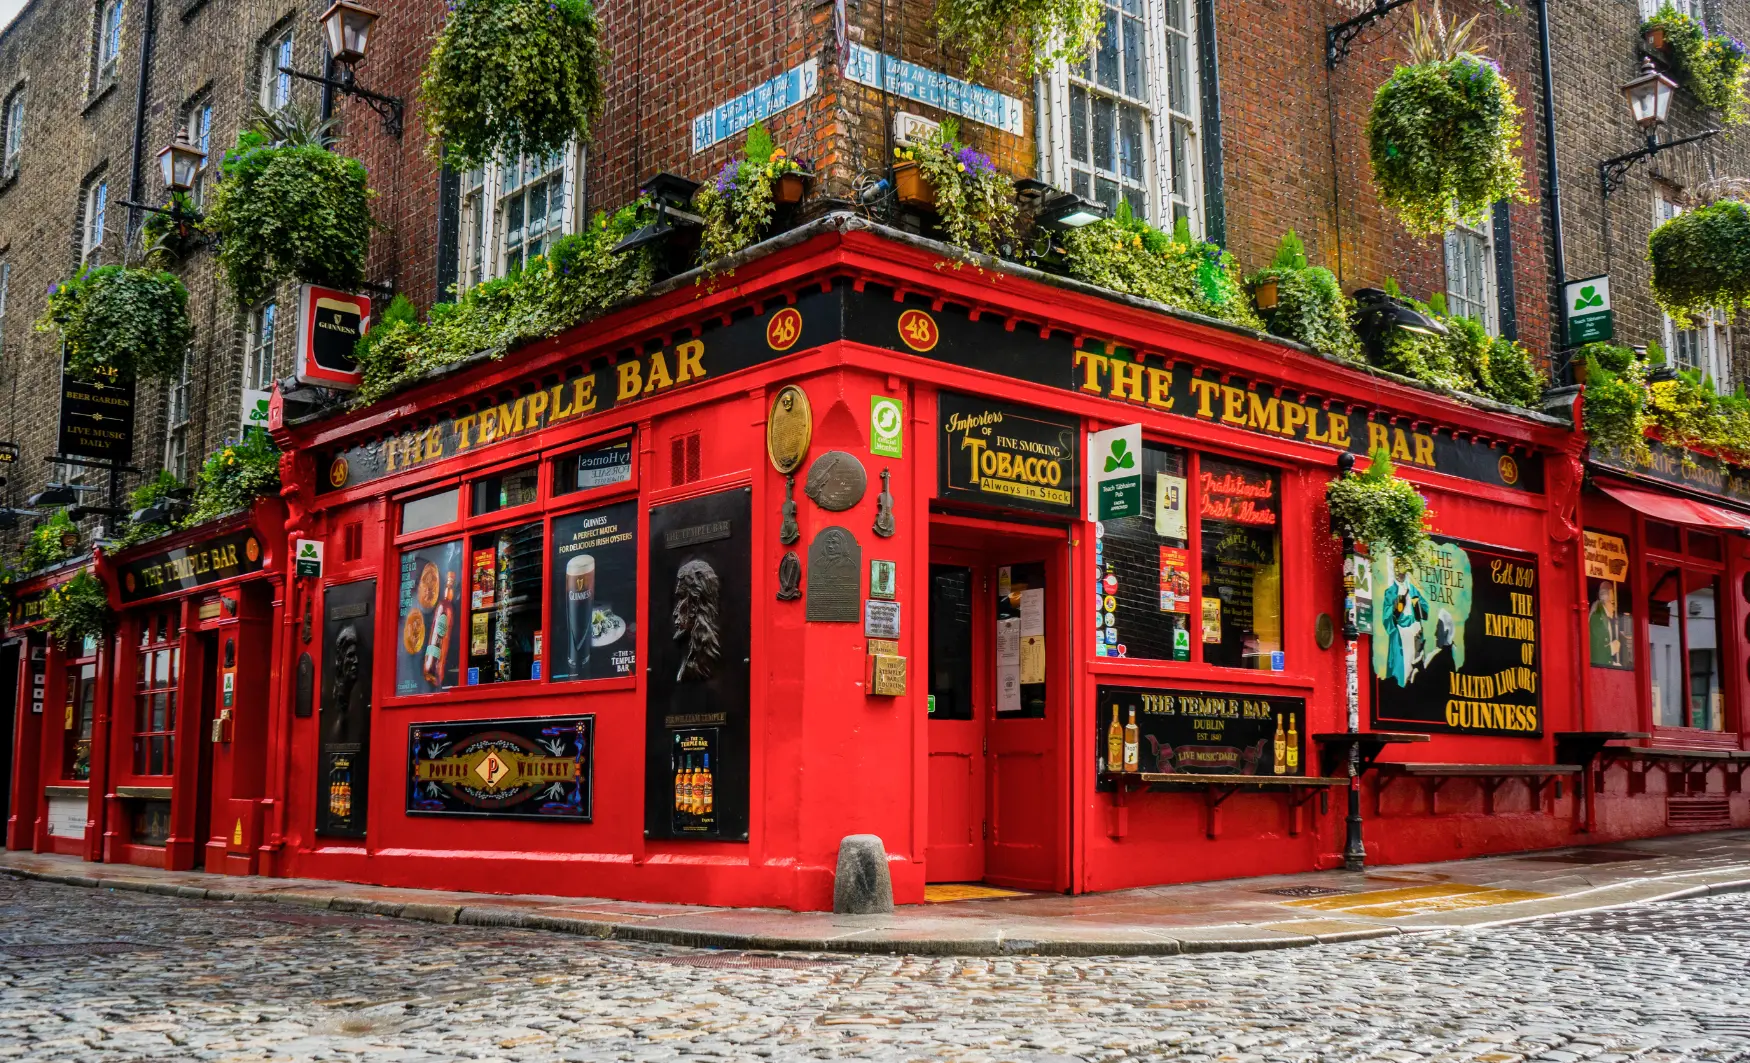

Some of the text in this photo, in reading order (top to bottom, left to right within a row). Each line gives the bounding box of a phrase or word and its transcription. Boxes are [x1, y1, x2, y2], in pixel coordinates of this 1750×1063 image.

[886, 75, 926, 99] TEMPLE
[962, 101, 999, 123] SOUTH
[318, 321, 356, 335] GUINNESS
[772, 316, 795, 344] 48
[904, 315, 930, 342] 48
[66, 391, 130, 407] BEER GARDEN
[384, 340, 708, 471] THE TEMPLE BAR
[1075, 350, 1436, 469] THE TEMPLE BAR
[67, 426, 126, 440] LIVE MUSIC
[945, 411, 1003, 437] Importers
[981, 426, 992, 436] OF
[80, 437, 112, 448] DAILY
[996, 435, 1060, 457] FINE SMOKING
[333, 463, 344, 482] 48
[961, 436, 1062, 487] TOBACCO
[1501, 460, 1513, 478] 48
[983, 479, 1069, 502] Always in Stock
[1200, 471, 1273, 498] Traditional
[1200, 493, 1233, 518] Irish
[1237, 500, 1276, 525] Music
[577, 528, 600, 540] PERFECT
[599, 524, 618, 535] MATCH
[583, 515, 608, 529] GUINNESS
[558, 544, 570, 554] FOR
[569, 539, 597, 551] DELICIOUS
[609, 531, 633, 543] OYSTERS
[1216, 535, 1248, 553] TEMPLE
[142, 564, 165, 588] THE
[165, 551, 210, 582] TEMPLE
[211, 543, 239, 570] BAR
[1430, 550, 1452, 569] THE
[1419, 566, 1465, 589] TEMPLE
[1515, 566, 1534, 588] 1840
[568, 589, 592, 601] GUINNESS
[1430, 585, 1455, 606] BAR
[1510, 592, 1533, 617] THE
[1484, 612, 1535, 641] EMPEROR
[611, 655, 636, 666] TEMPLE
[1521, 643, 1534, 665] OF
[616, 664, 630, 673] BAR
[1449, 667, 1538, 699] MALTED LIQUORS
[1142, 694, 1272, 720] THE TEMPLE BAR
[1445, 700, 1537, 732] GUINNESS
[1193, 719, 1225, 730] DUBLIN
[1178, 751, 1238, 763] LIVE MUSIC DAILY
[429, 763, 469, 777] POWERS
[517, 761, 569, 777] WHISKEY
